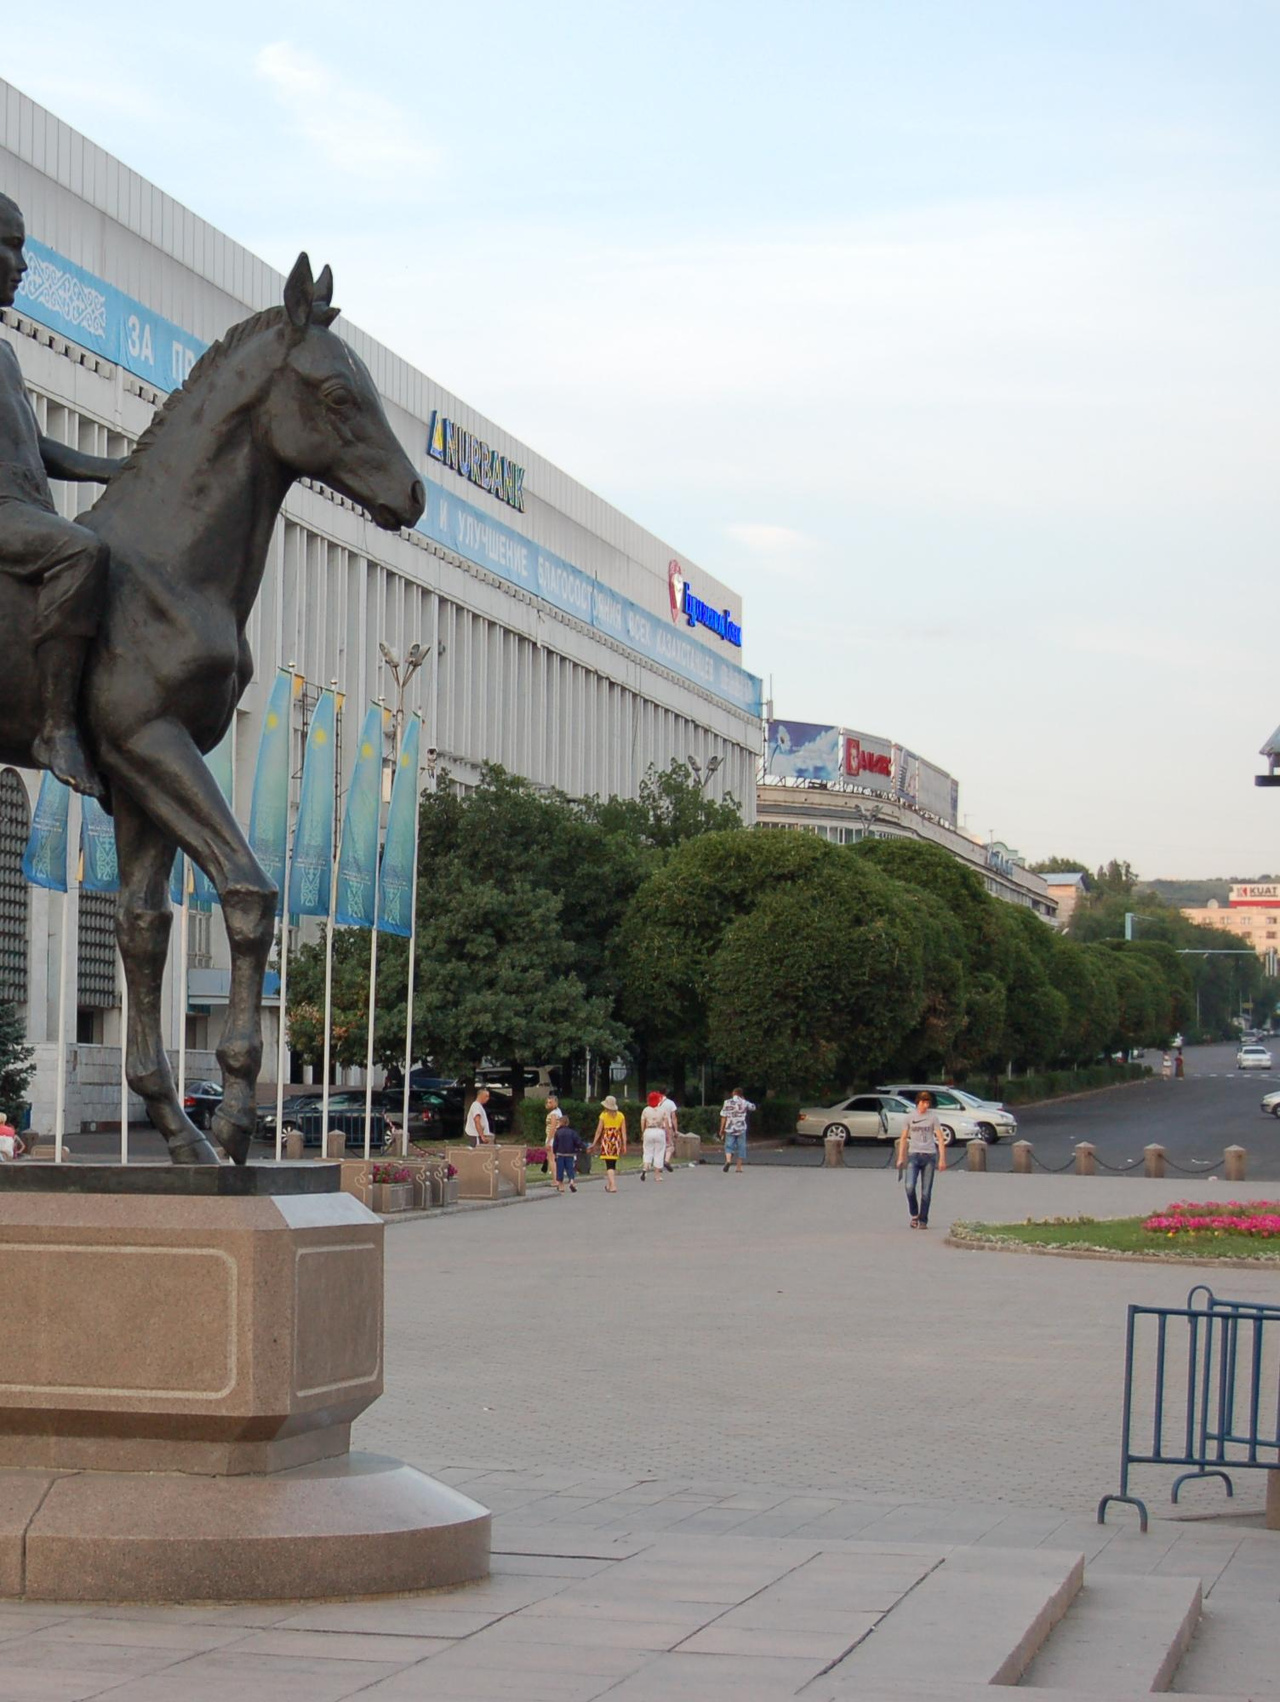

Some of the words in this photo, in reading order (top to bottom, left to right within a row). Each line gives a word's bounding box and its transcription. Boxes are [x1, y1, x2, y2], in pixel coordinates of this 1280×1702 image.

[128, 315, 154, 366] ЗА
[440, 498, 448, 532] И
[457, 510, 528, 577] УЛУЧШЕНИЕ
[442, 418, 525, 513] NURBANK
[1250, 886, 1277, 895] KUAT
